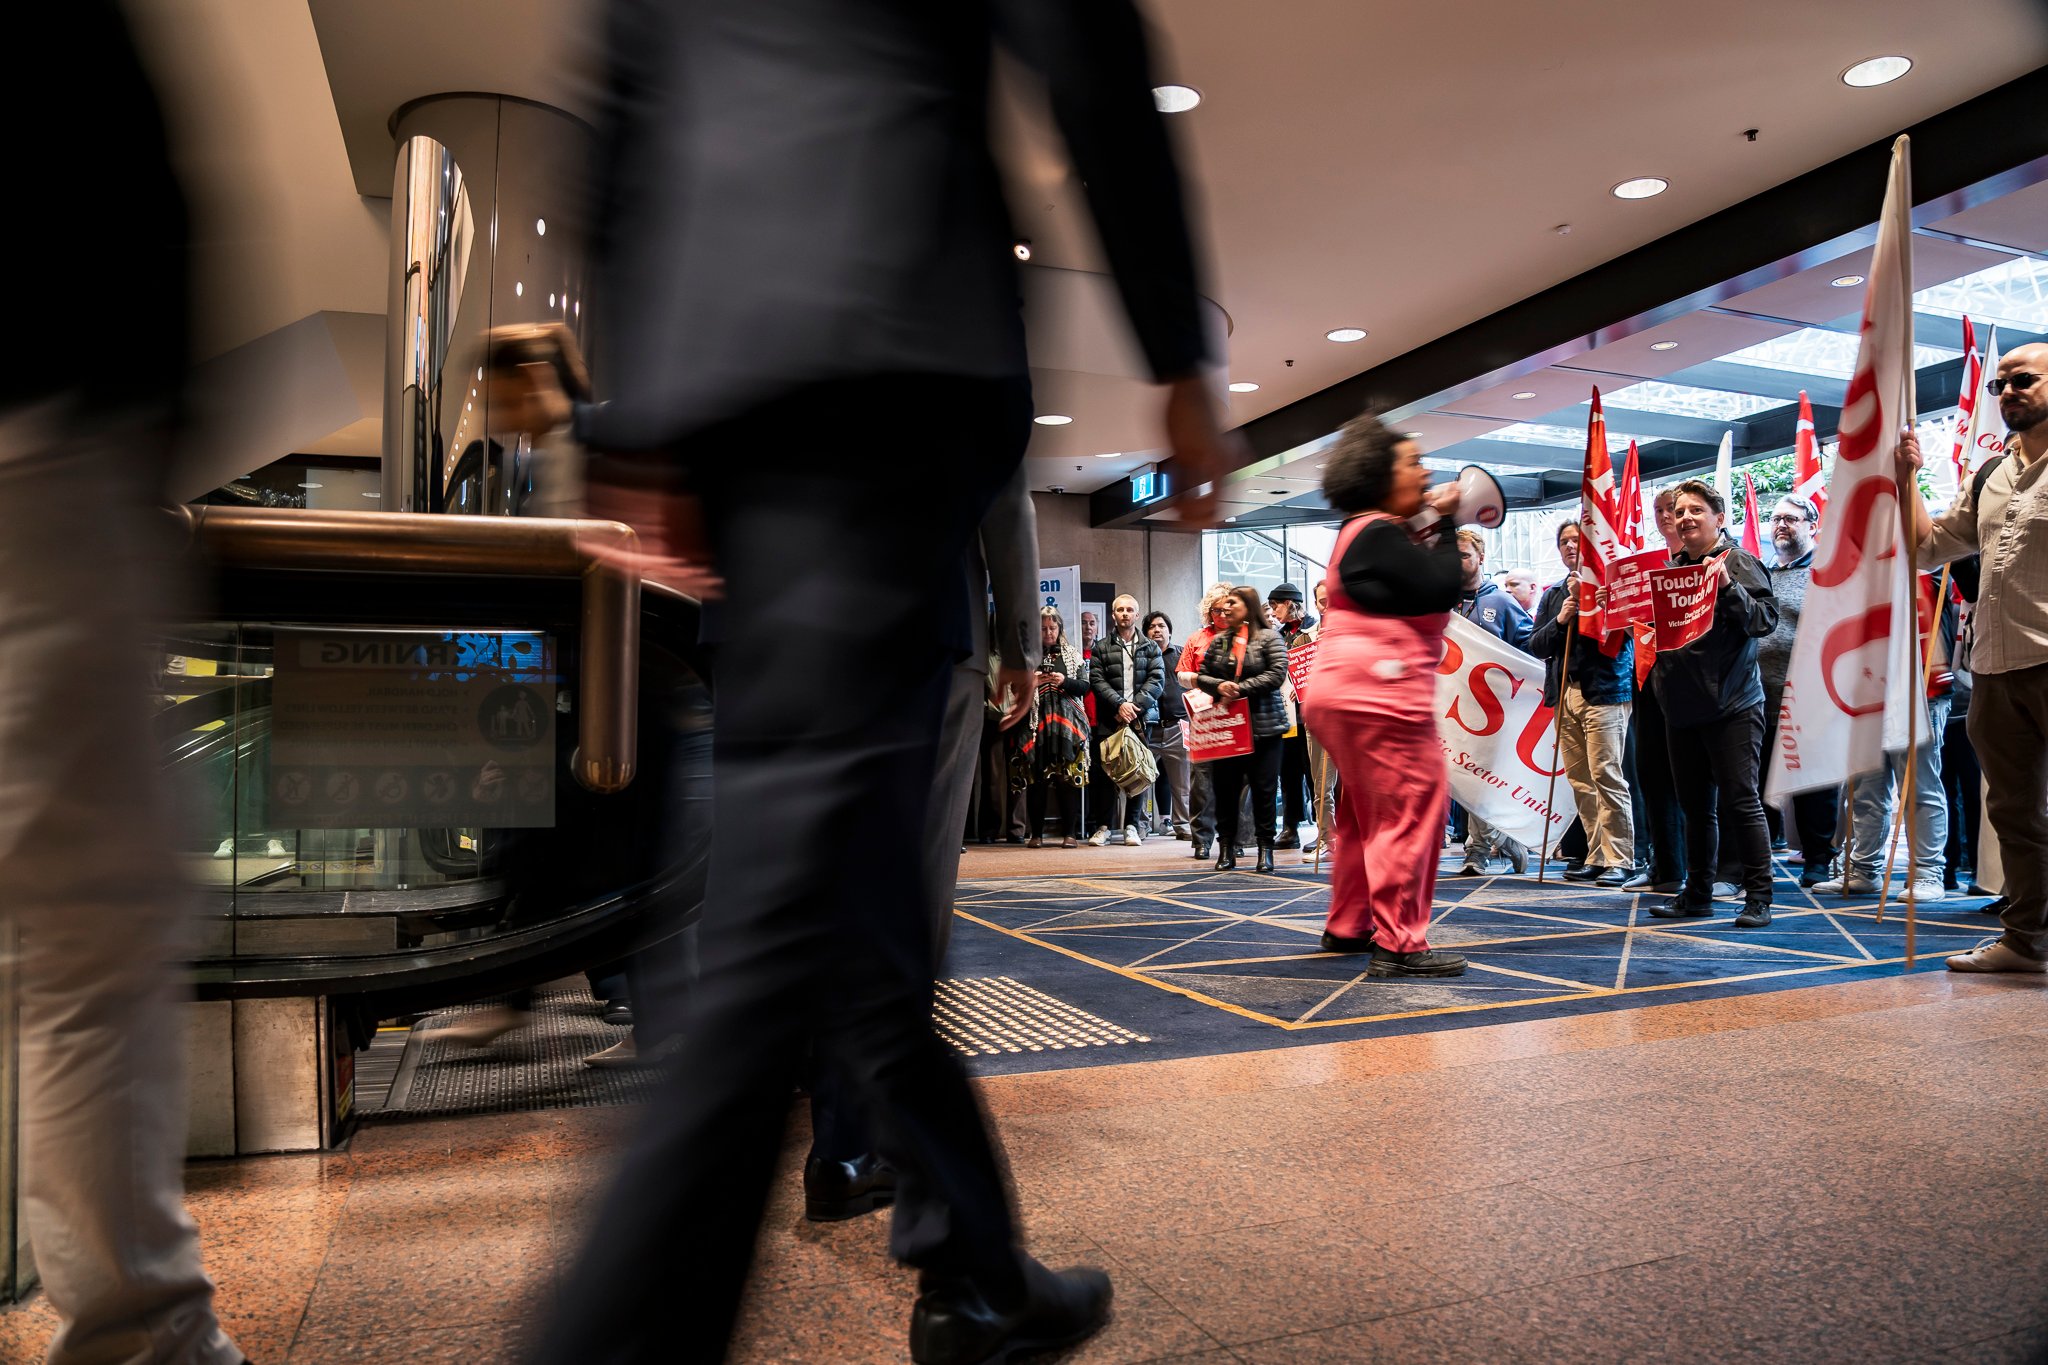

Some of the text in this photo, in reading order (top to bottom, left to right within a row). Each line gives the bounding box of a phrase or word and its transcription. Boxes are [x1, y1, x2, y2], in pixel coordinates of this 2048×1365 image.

[1652, 571, 1703, 592] Touch
[1046, 596, 1059, 608] &
[1667, 586, 1706, 609] Touch
[1289, 645, 1319, 659] Impartially
[1292, 669, 1306, 677] VPS
[1296, 660, 1314, 670] sectio
[1780, 681, 1802, 771] Union
[1452, 751, 1509, 789] Sector
[1511, 785, 1564, 825] Union
